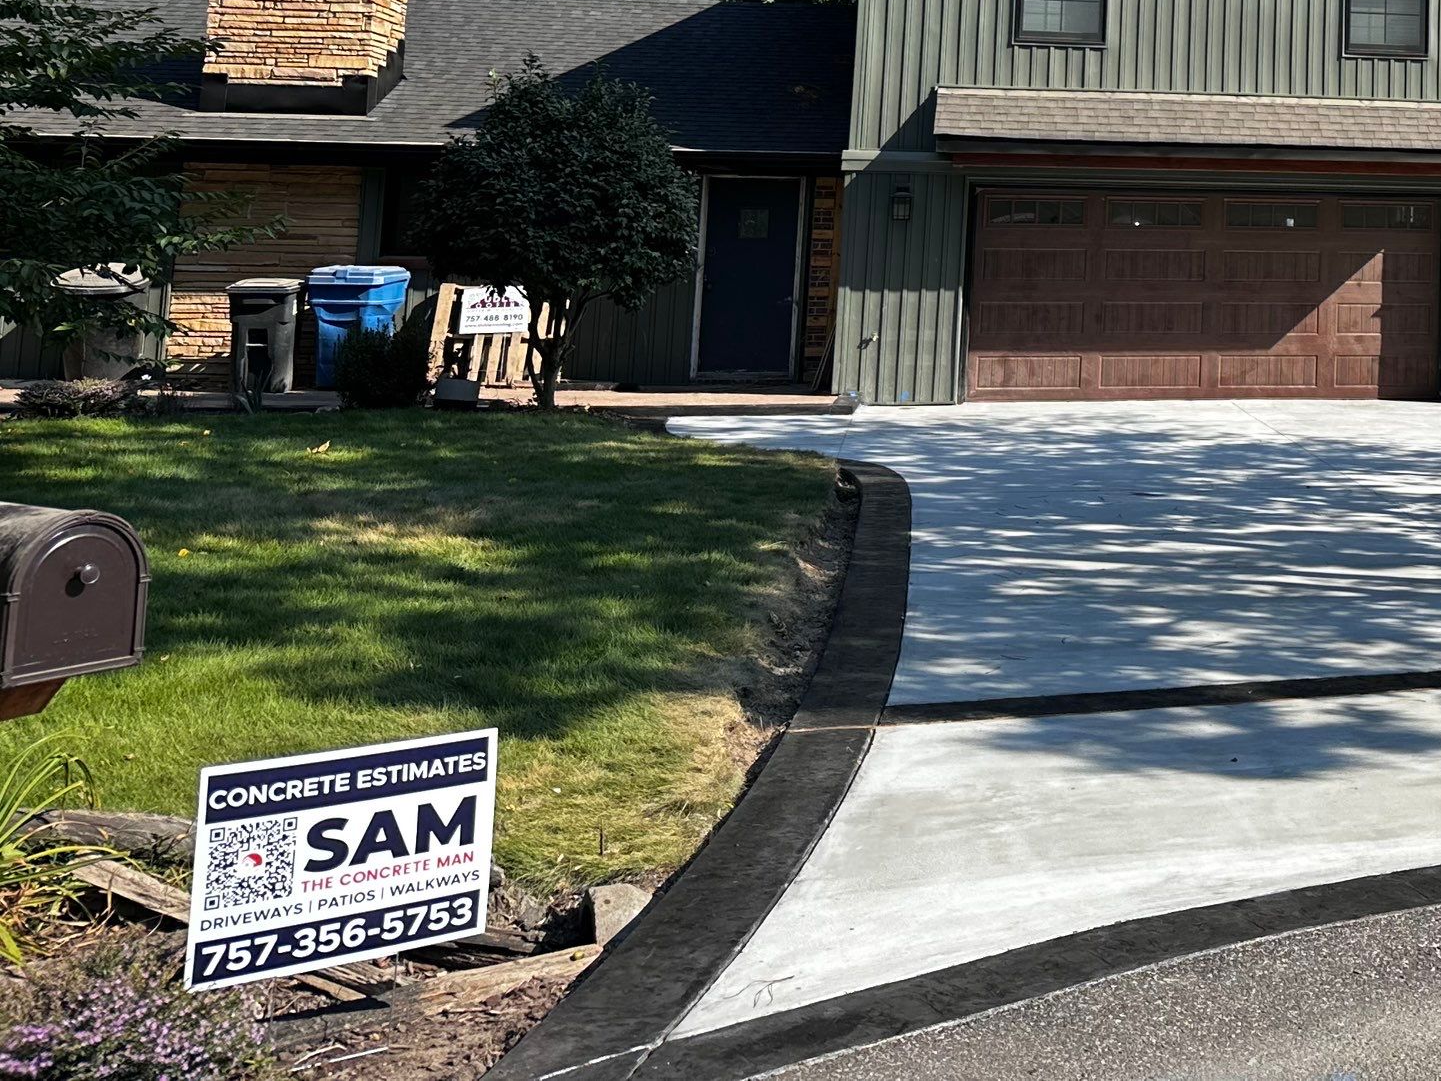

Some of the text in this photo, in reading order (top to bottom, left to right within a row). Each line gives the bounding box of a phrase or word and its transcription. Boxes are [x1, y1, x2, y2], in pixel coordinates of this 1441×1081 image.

[465, 315, 481, 323] 757
[208, 752, 487, 810] CONCRETE ESTIMATES
[303, 795, 477, 872] SAM
[200, 870, 480, 932] DRIVEWAYS PATIOS WALKWAYS
[301, 850, 474, 893] THE CONCRETE MAN
[201, 897, 474, 977] 757-356-5753
